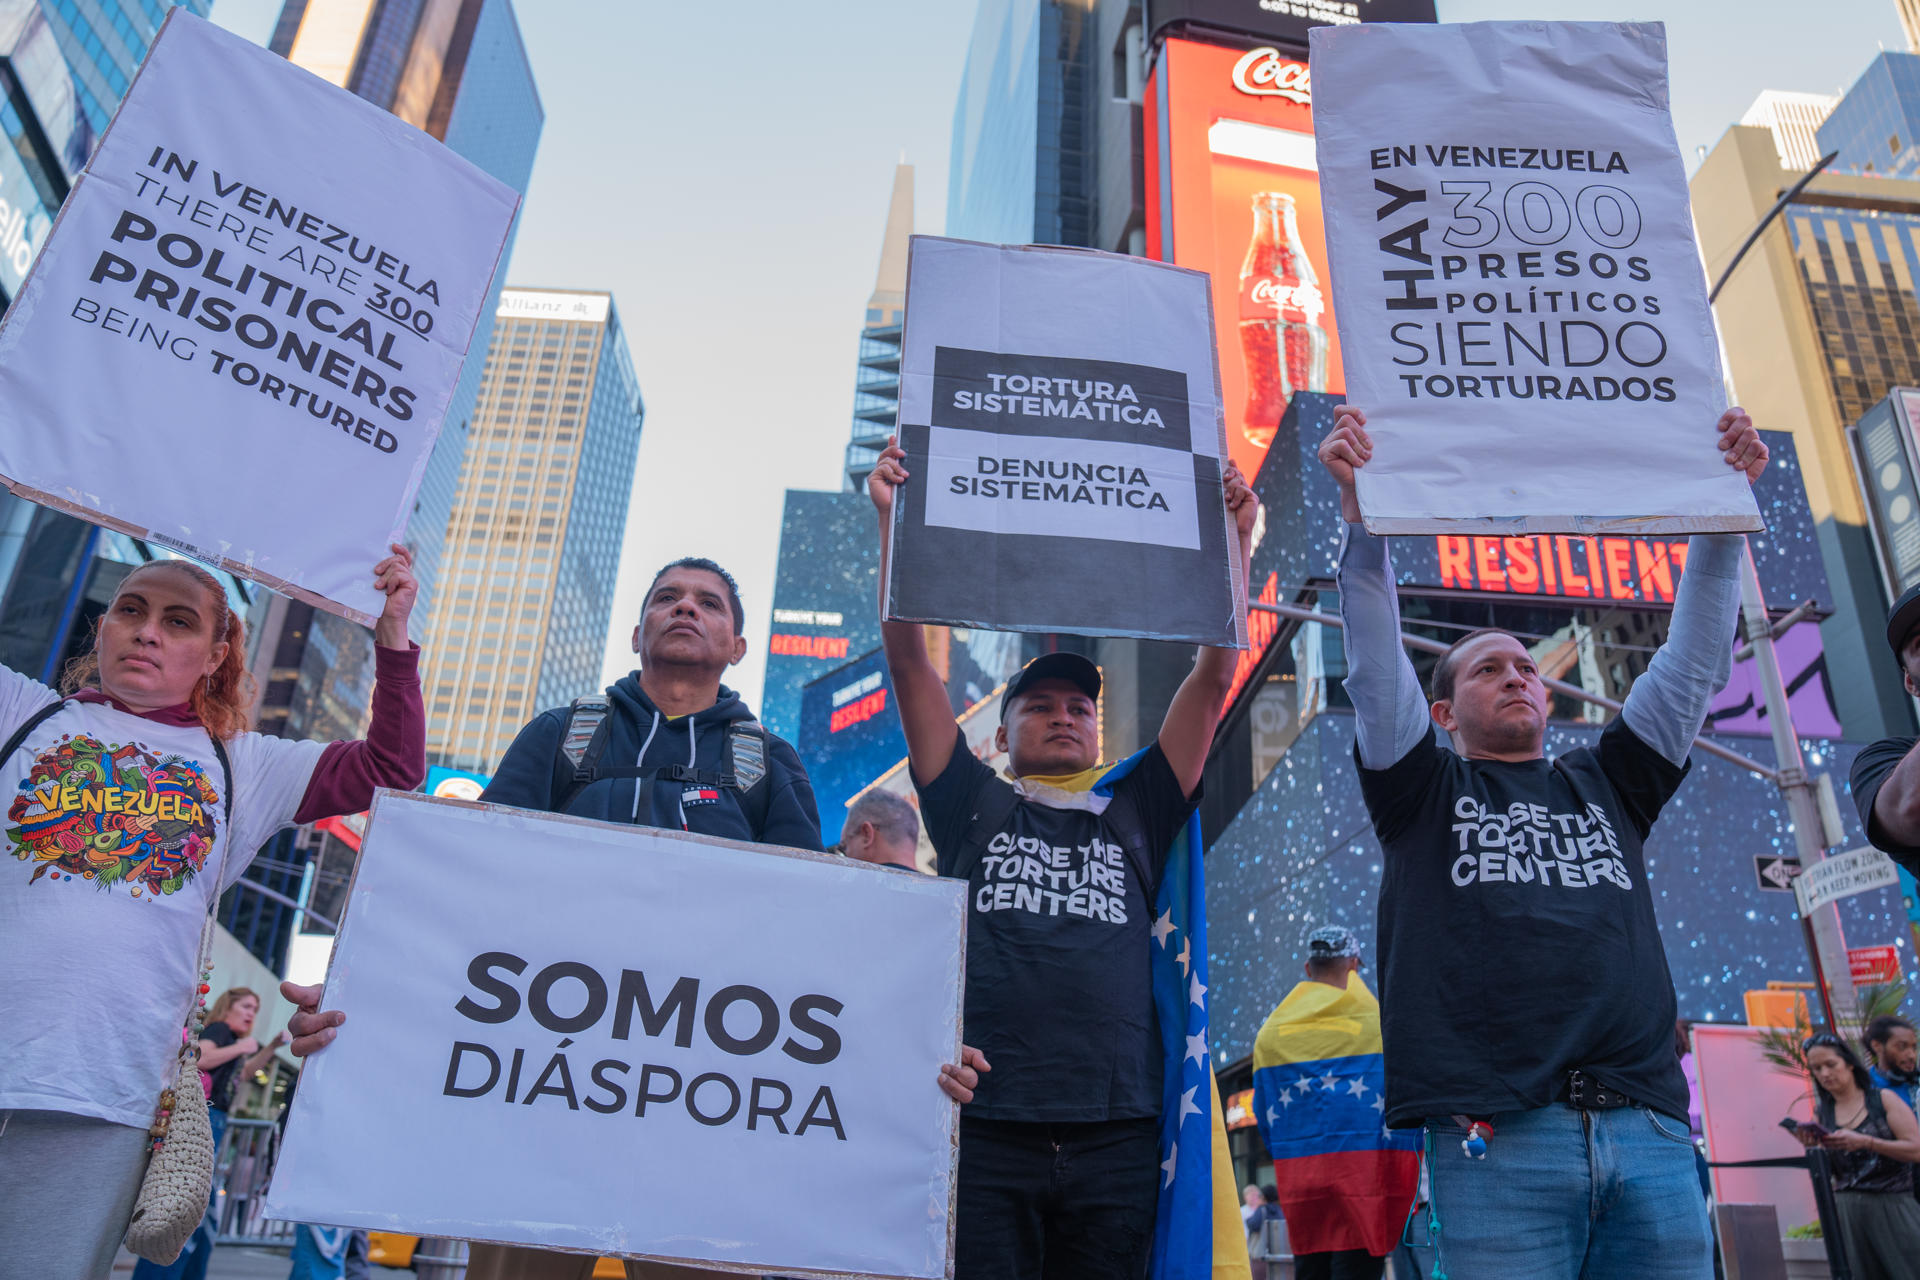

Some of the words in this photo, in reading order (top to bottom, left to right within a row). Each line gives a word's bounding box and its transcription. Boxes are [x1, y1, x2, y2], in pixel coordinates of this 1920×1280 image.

[1369, 144, 1417, 171] EN
[1424, 144, 1630, 175] VENEZUELA
[147, 145, 199, 184] IN
[212, 170, 440, 307] VENEZUELA
[1440, 179, 1642, 250] 300
[135, 171, 274, 256] THERE
[278, 245, 362, 296] ARE
[364, 282, 434, 338] 300
[1373, 177, 1439, 311] HAY
[1440, 251, 1652, 282] PRESOS
[110, 209, 404, 372] POLITICAL
[1445, 285, 1661, 315] POLÍTICOS
[88, 250, 417, 421] PRISONERS
[1390, 320, 1668, 368] SIENDO
[70, 296, 198, 361] BEING
[210, 349, 399, 454] TORTURED
[986, 372, 1140, 404] TORTURA
[1399, 374, 1677, 403] TORTURADOS
[952, 390, 1166, 429] SISTEMÁTICA
[977, 456, 1151, 488] DENUNCIA
[949, 475, 1171, 513] SISTEMÁTICA
[34, 784, 206, 828] VENEZUELA
[1454, 795, 1551, 833] CLOSE
[1550, 802, 1612, 835] THE
[987, 831, 1072, 868] CLOSE
[1077, 837, 1125, 869] THE
[1451, 821, 1624, 861] TORTURE
[981, 854, 1127, 897] TORTURE
[1451, 851, 1633, 891] CENTERS
[975, 882, 1129, 925] CENTERS
[454, 951, 845, 1065] SOMOS
[442, 1037, 848, 1141] DIÁSPORA
